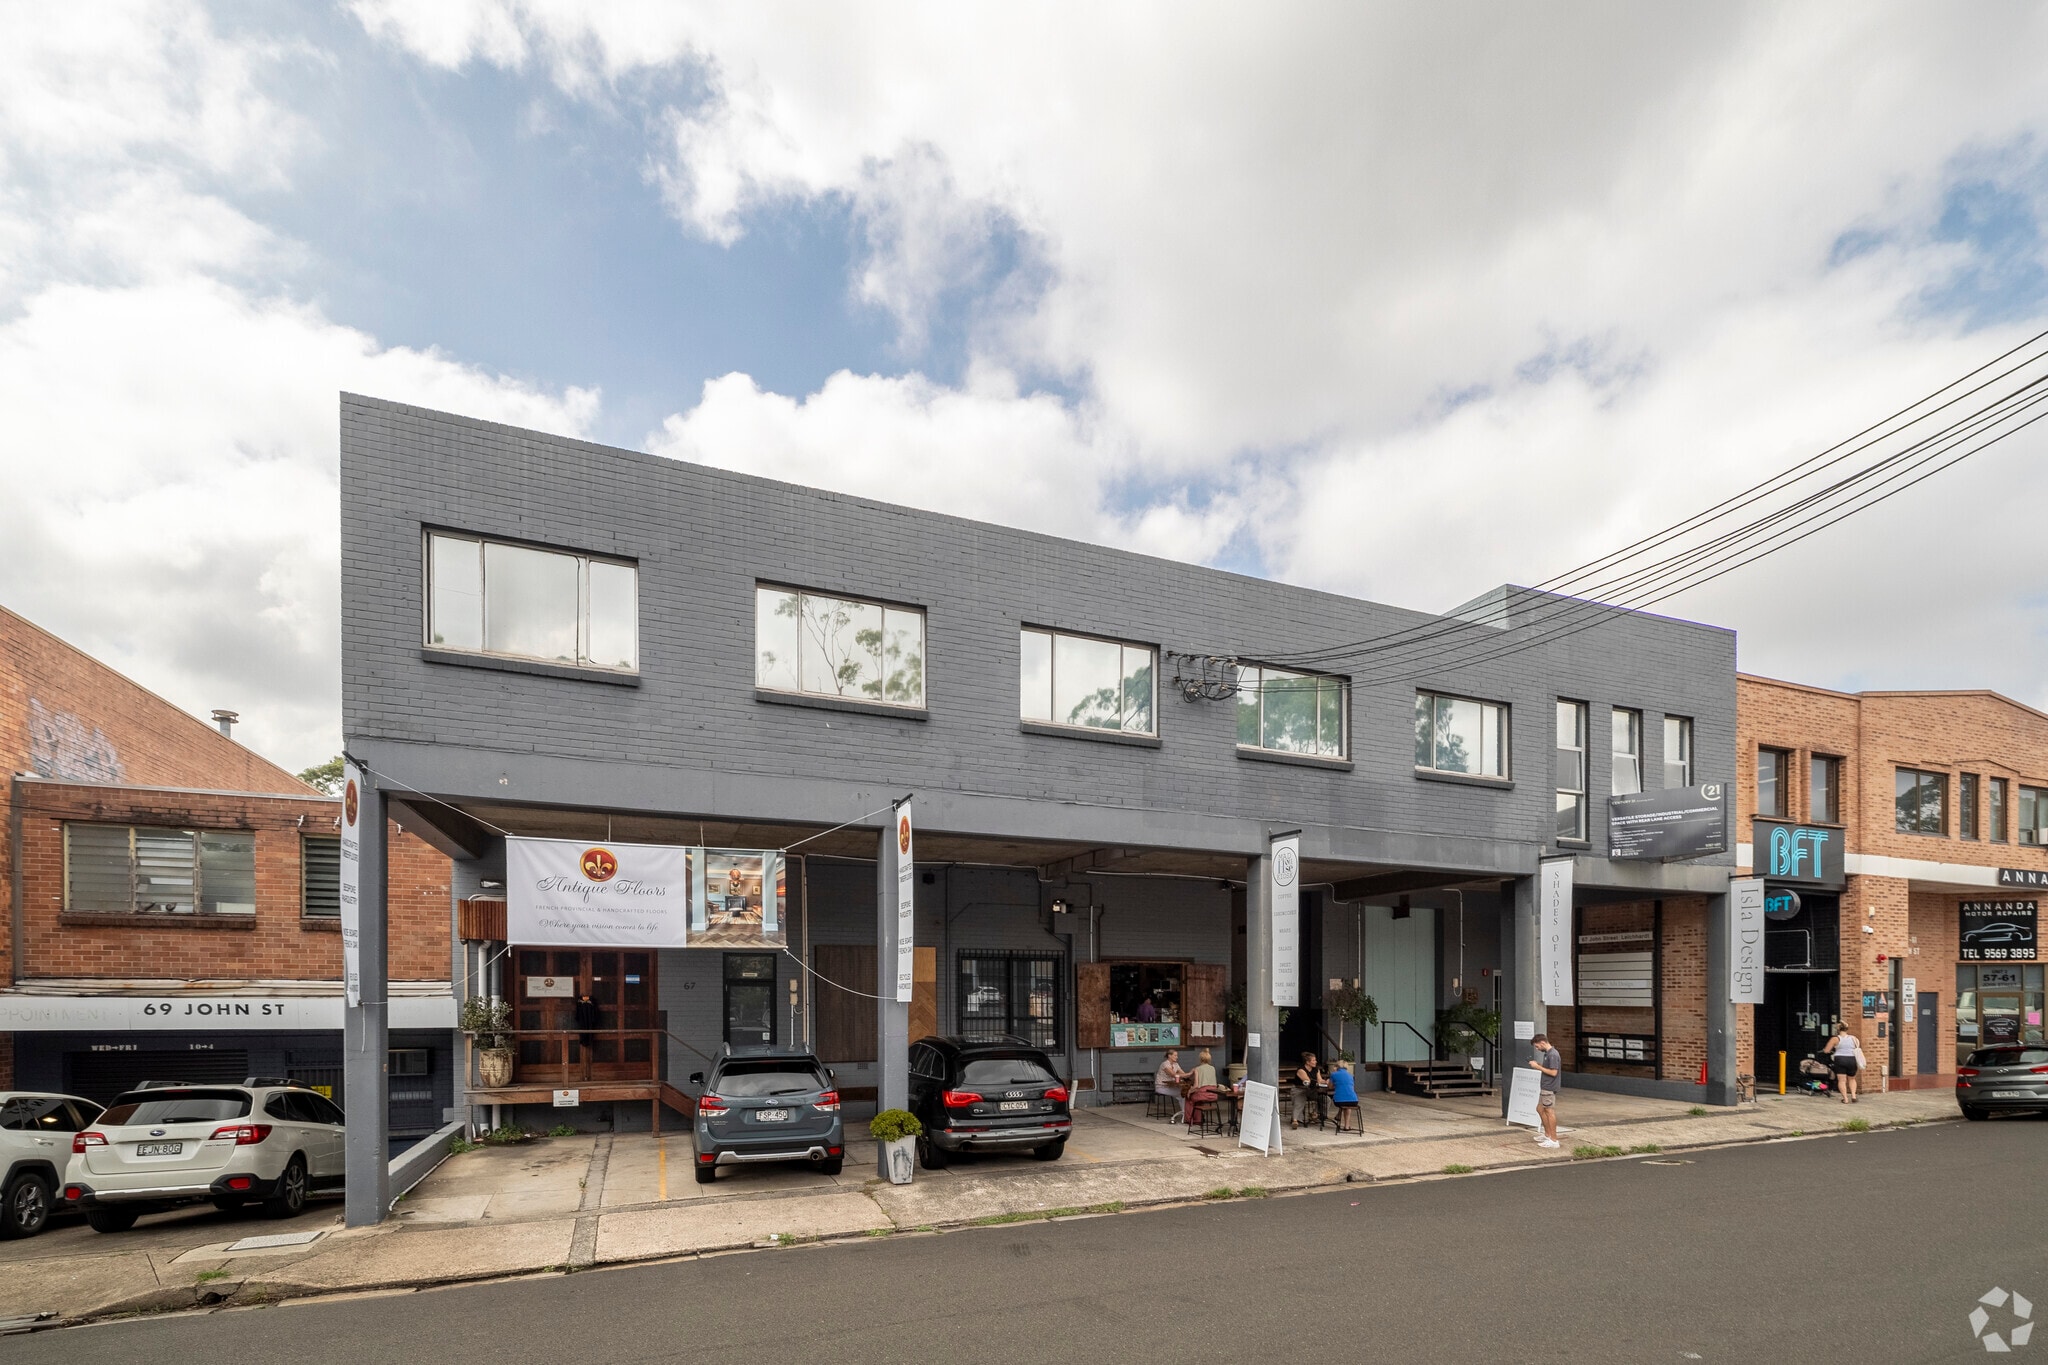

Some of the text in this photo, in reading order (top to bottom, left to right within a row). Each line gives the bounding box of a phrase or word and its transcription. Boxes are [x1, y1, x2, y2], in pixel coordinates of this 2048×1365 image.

[1770, 826, 1829, 878] BFT
[536, 874, 667, 904] Antique Floors
[1552, 871, 1560, 926] SHADES
[1764, 895, 1793, 912] BFT
[1963, 902, 2035, 911] ANNANDA
[539, 918, 569, 929] Where
[568, 923, 590, 934] your
[591, 922, 614, 931] vision
[637, 922, 646, 931] to
[646, 921, 660, 935] life
[1551, 935, 1560, 952] OF
[1733, 888, 1762, 995] Isla Design
[1962, 948, 2036, 959] TEL 9569 3895
[683, 982, 696, 990] 67
[1983, 974, 2016, 982] 57-61
[143, 1003, 285, 1016] 69 JOHN ST
